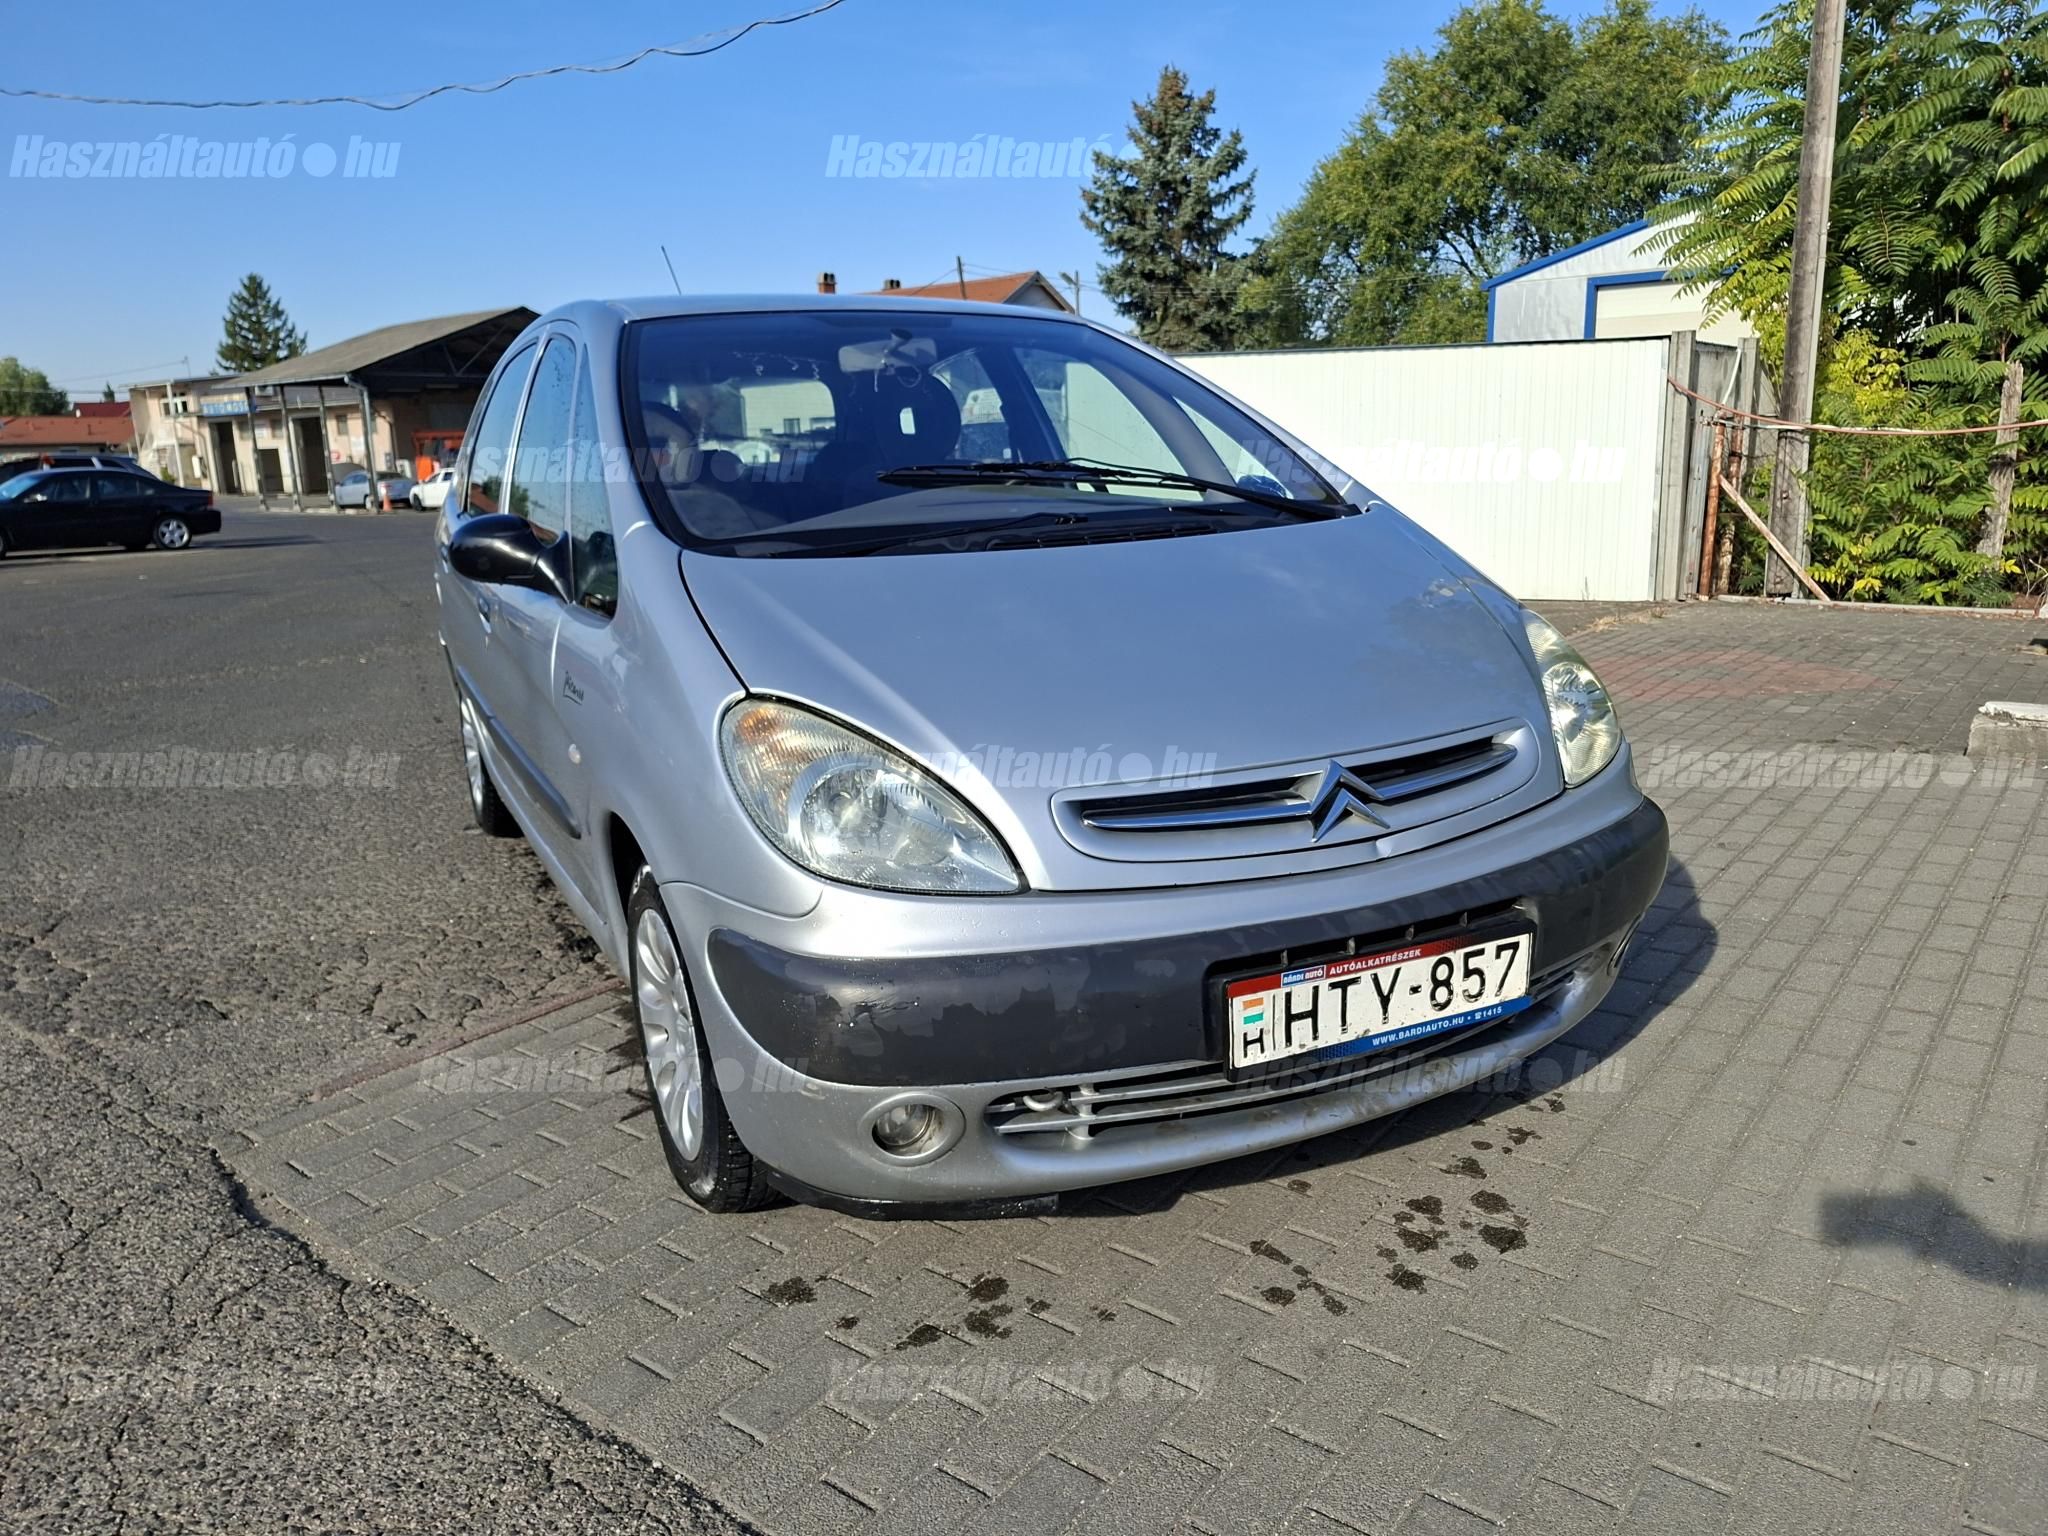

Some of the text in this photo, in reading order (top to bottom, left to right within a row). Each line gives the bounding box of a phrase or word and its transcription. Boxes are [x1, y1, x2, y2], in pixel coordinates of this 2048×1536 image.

[1329, 948, 1422, 976] AUTÓALKATRÉSZEK
[1284, 941, 1521, 1049] HTY-857
[1242, 1028, 1265, 1059] H
[1371, 1006, 1503, 1047] WWW.BARDIAUTO.HU 1415
